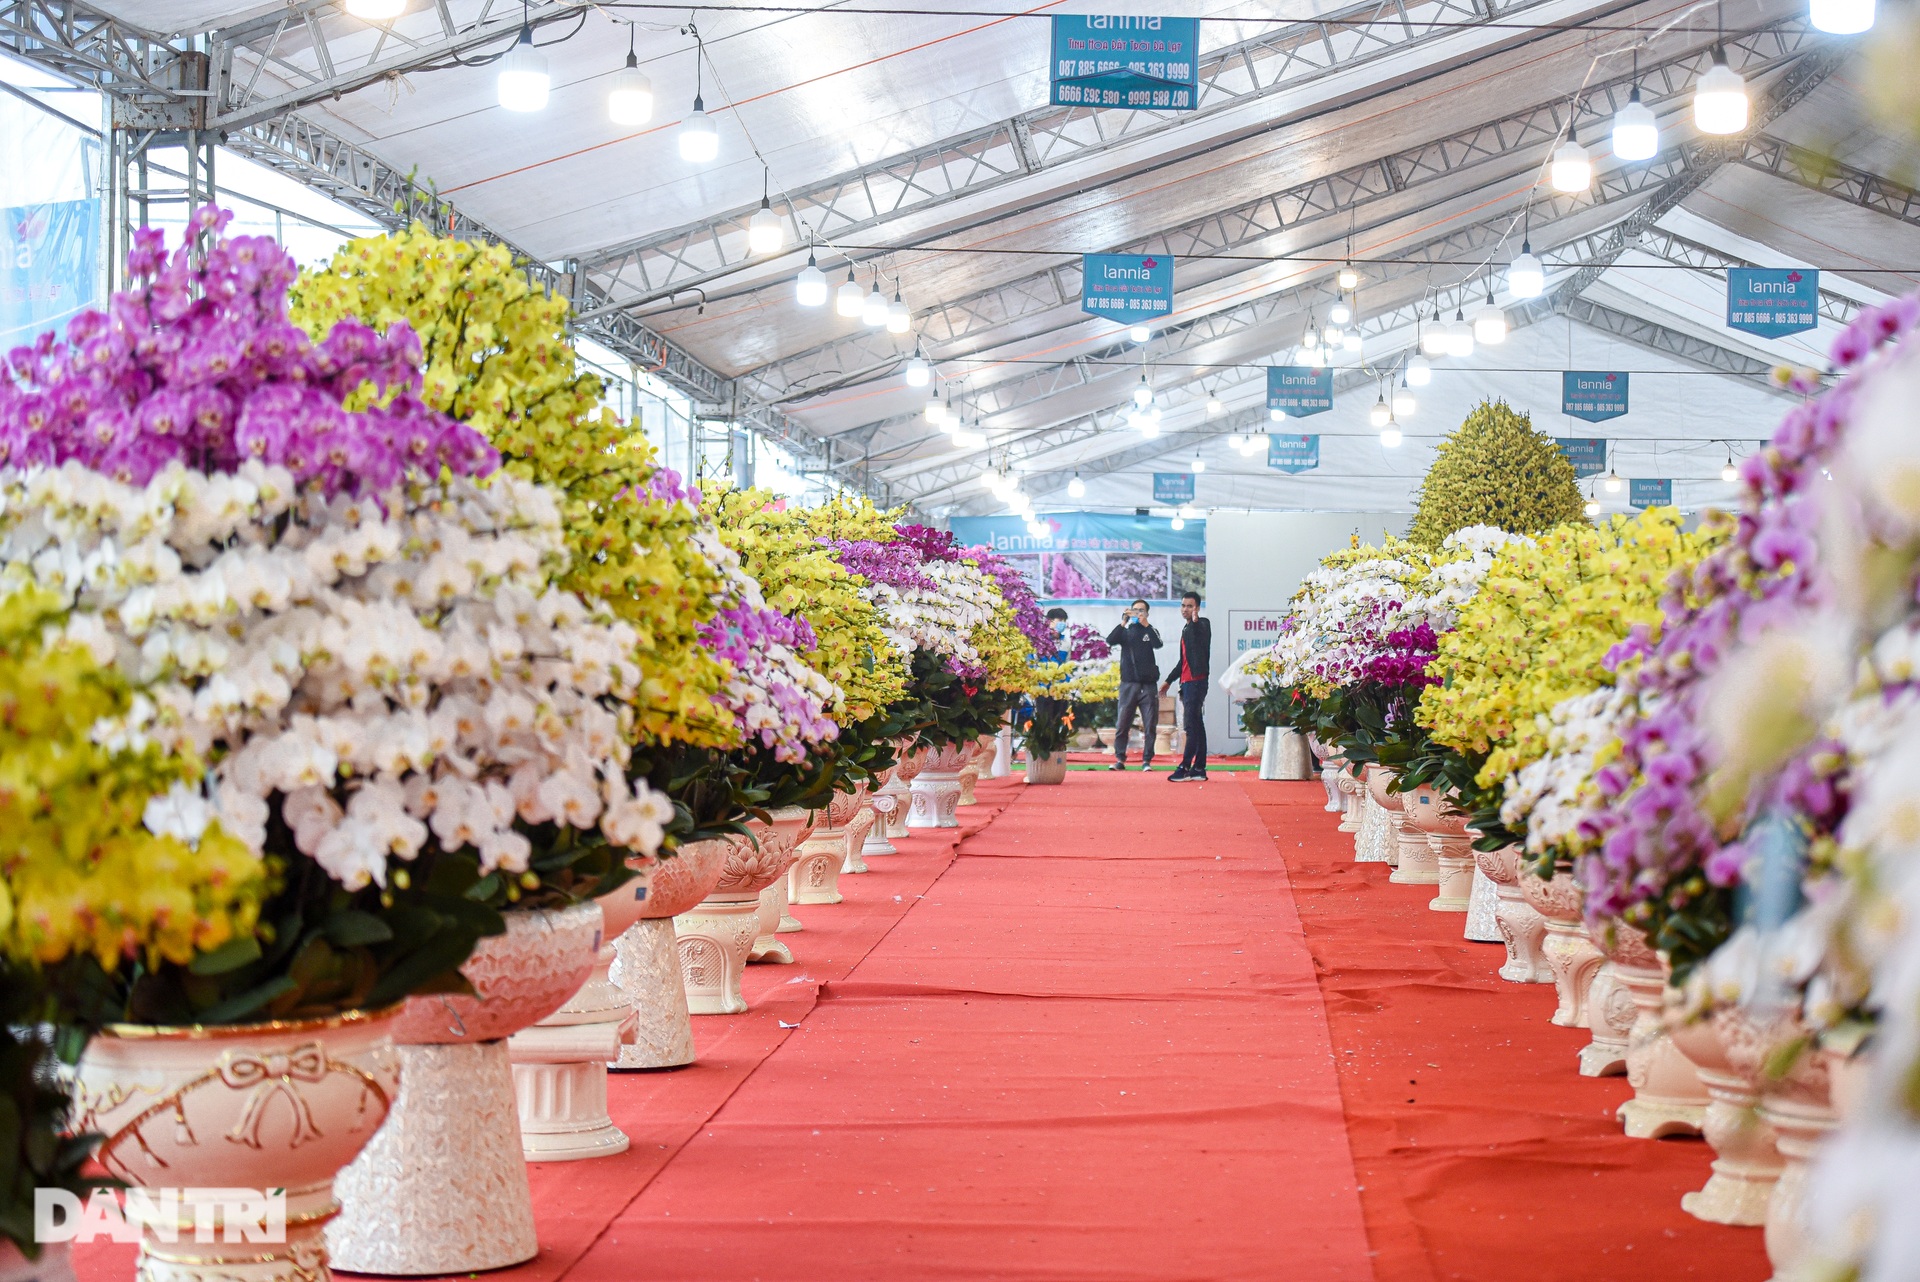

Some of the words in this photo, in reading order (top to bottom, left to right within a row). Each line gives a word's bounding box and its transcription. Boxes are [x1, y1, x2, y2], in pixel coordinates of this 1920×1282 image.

[1059, 60, 1076, 76] 087
[1078, 60, 1095, 76] 885
[1148, 62, 1165, 78] 363
[1167, 62, 1189, 79] 9999
[1104, 264, 1150, 280] lannia
[1749, 278, 1795, 294] lannia
[1282, 374, 1316, 385] lannia
[1578, 379, 1612, 390] lannia
[1279, 439, 1307, 449] lannia
[1244, 616, 1278, 631] ĐIỂM
